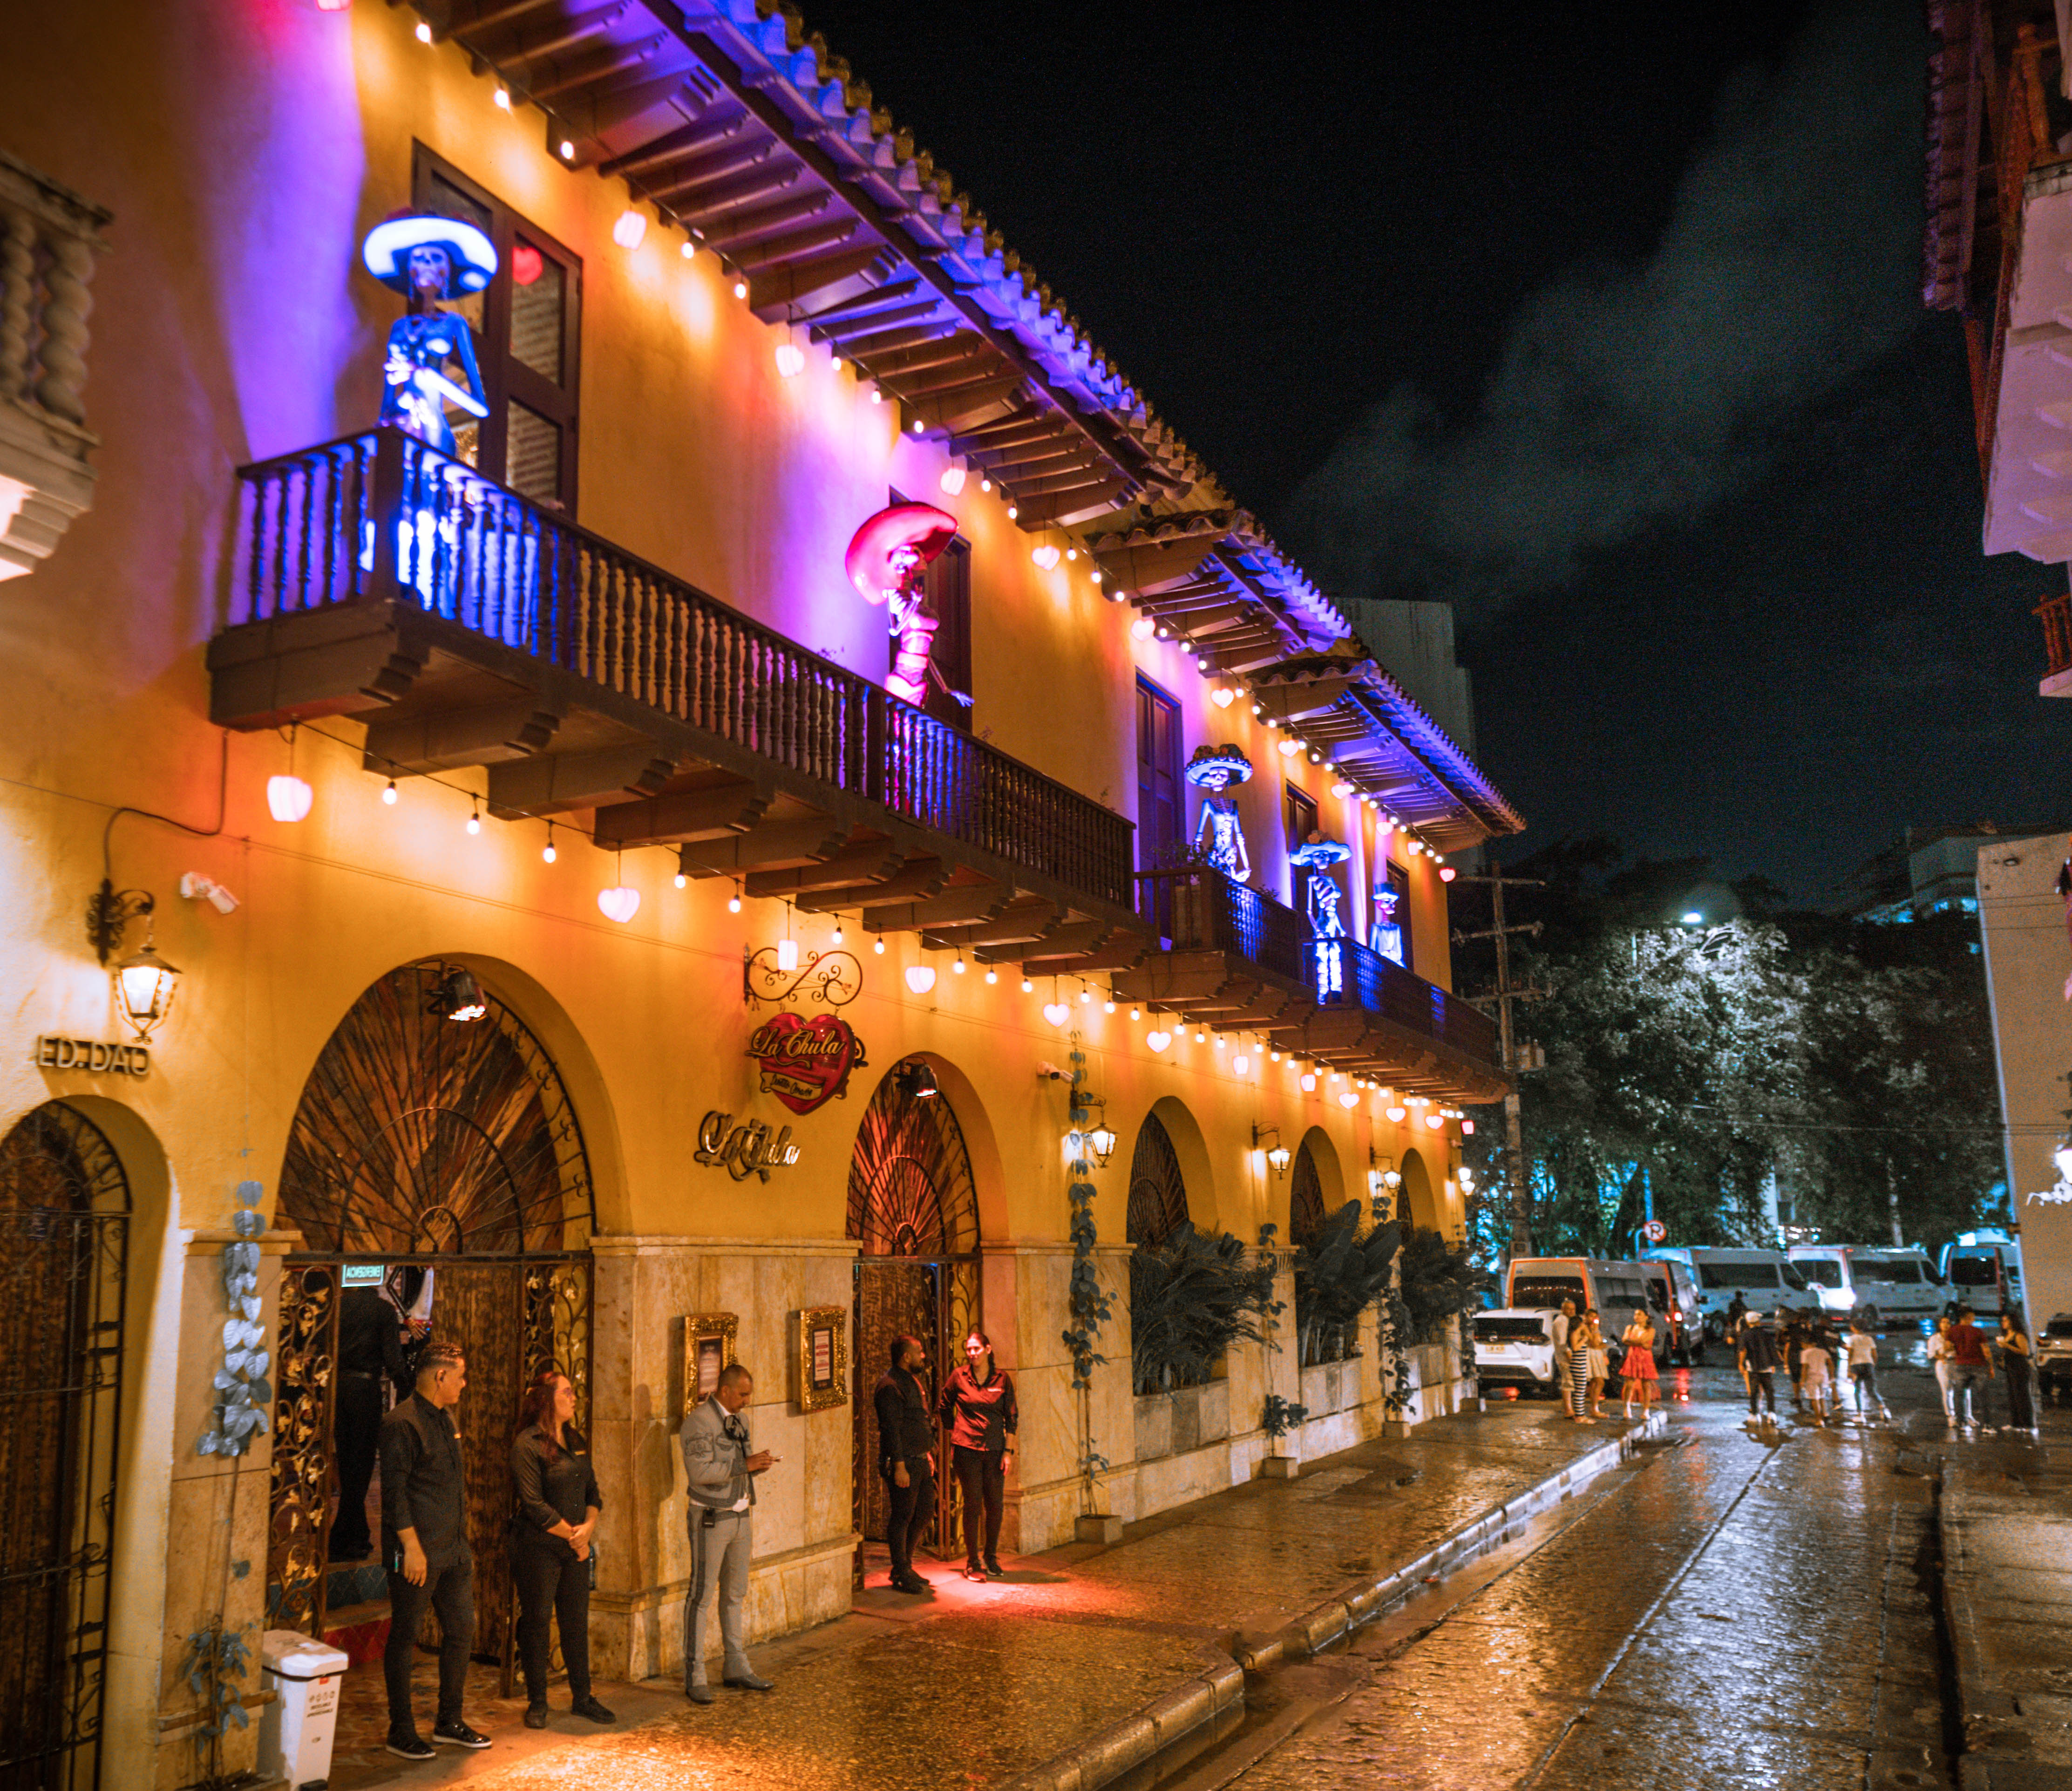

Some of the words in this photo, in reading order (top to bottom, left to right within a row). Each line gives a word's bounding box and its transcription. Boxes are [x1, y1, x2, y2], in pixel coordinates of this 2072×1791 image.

[745, 1026, 783, 1057] La
[779, 1028, 846, 1068] Chula
[1650, 1224, 1661, 1237] P
